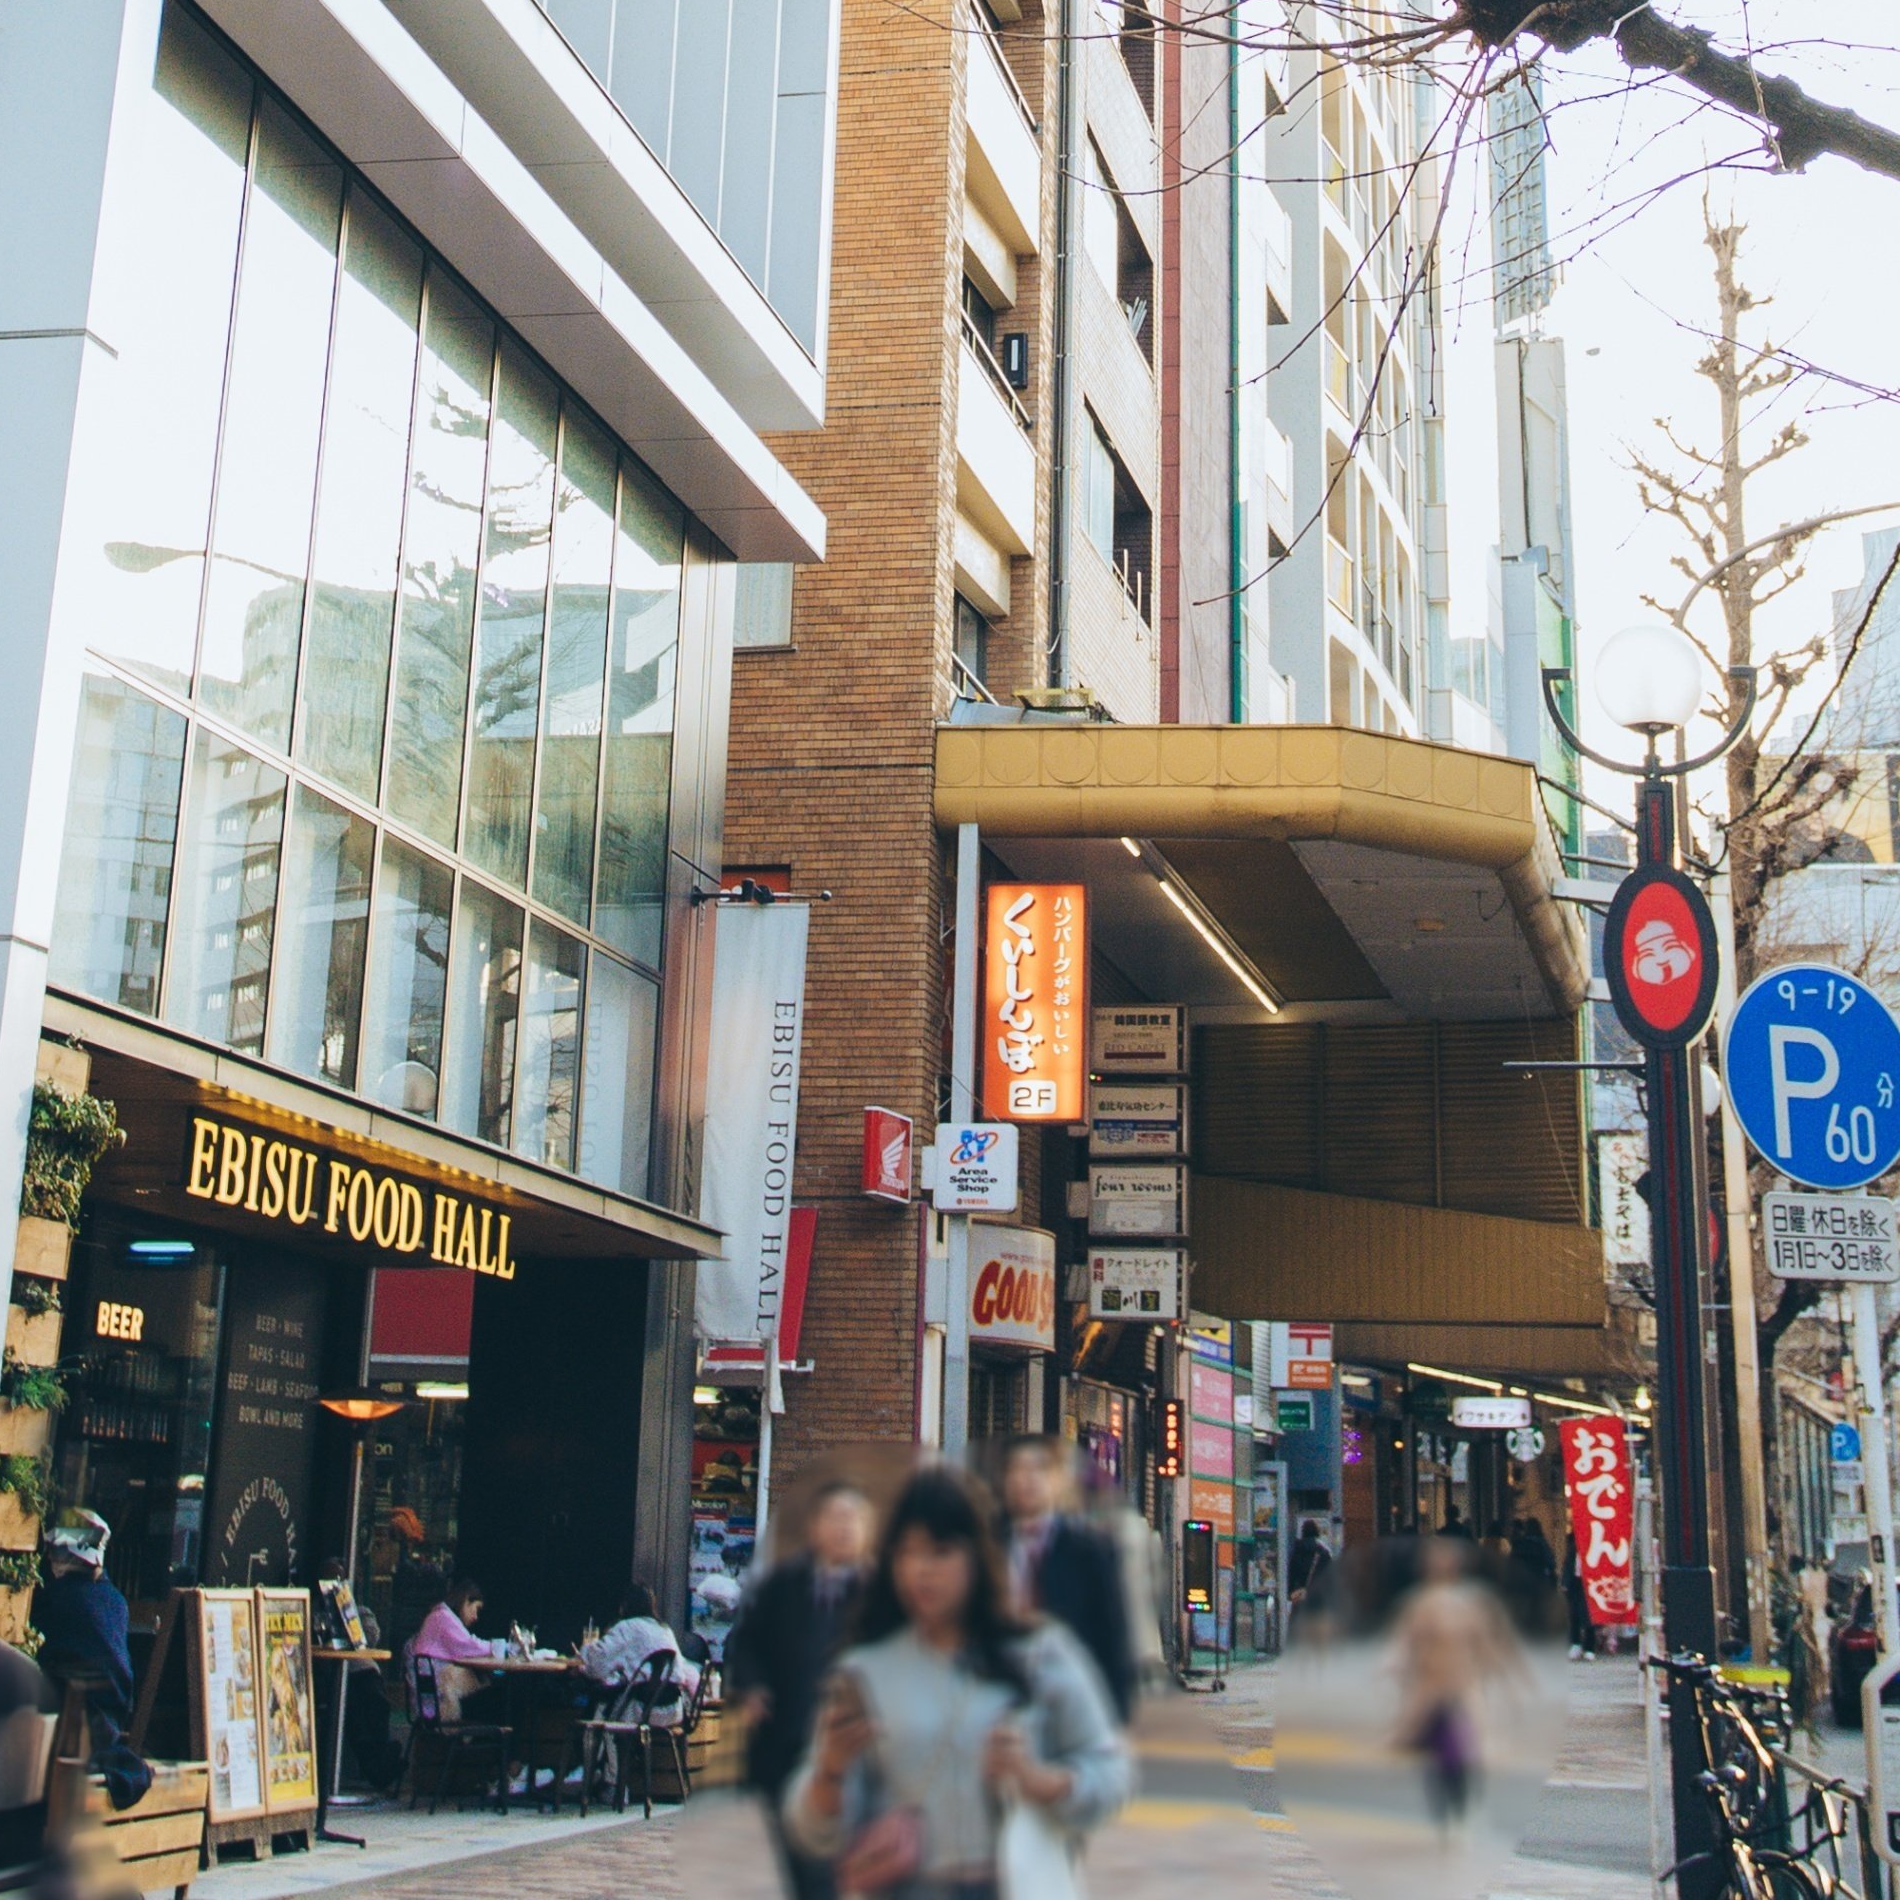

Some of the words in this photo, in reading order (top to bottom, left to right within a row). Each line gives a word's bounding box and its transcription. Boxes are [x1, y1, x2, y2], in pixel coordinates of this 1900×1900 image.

[998, 892, 1043, 1074] くいしんぼ
[1053, 896, 1072, 1055] ハンバーグがおいしい
[1777, 978, 1857, 1016] 9-19
[768, 1000, 797, 1106] EBISU
[1013, 1086, 1052, 1108] 2F
[1769, 1023, 1841, 1160] P
[1876, 1071, 1895, 1110] 分
[1825, 1101, 1878, 1166] 60
[763, 1120, 790, 1218] FOOD
[949, 1175, 998, 1184] Service
[957, 1184, 990, 1194] Shop
[958, 1166, 989, 1176] Area
[186, 1116, 318, 1224] EBISU
[323, 1160, 424, 1252] FOOD
[430, 1193, 516, 1280] HALL
[755, 1231, 783, 1333] HALL
[97, 1300, 144, 1341] BEER
[256, 1314, 278, 1332] BEER
[227, 1371, 249, 1391] BEEF
[255, 1375, 278, 1396] LAMB
[238, 1404, 262, 1424] BOWL
[263, 1407, 281, 1427] AND
[282, 1409, 304, 1430] MORE
[1572, 1427, 1629, 1569] おでん
